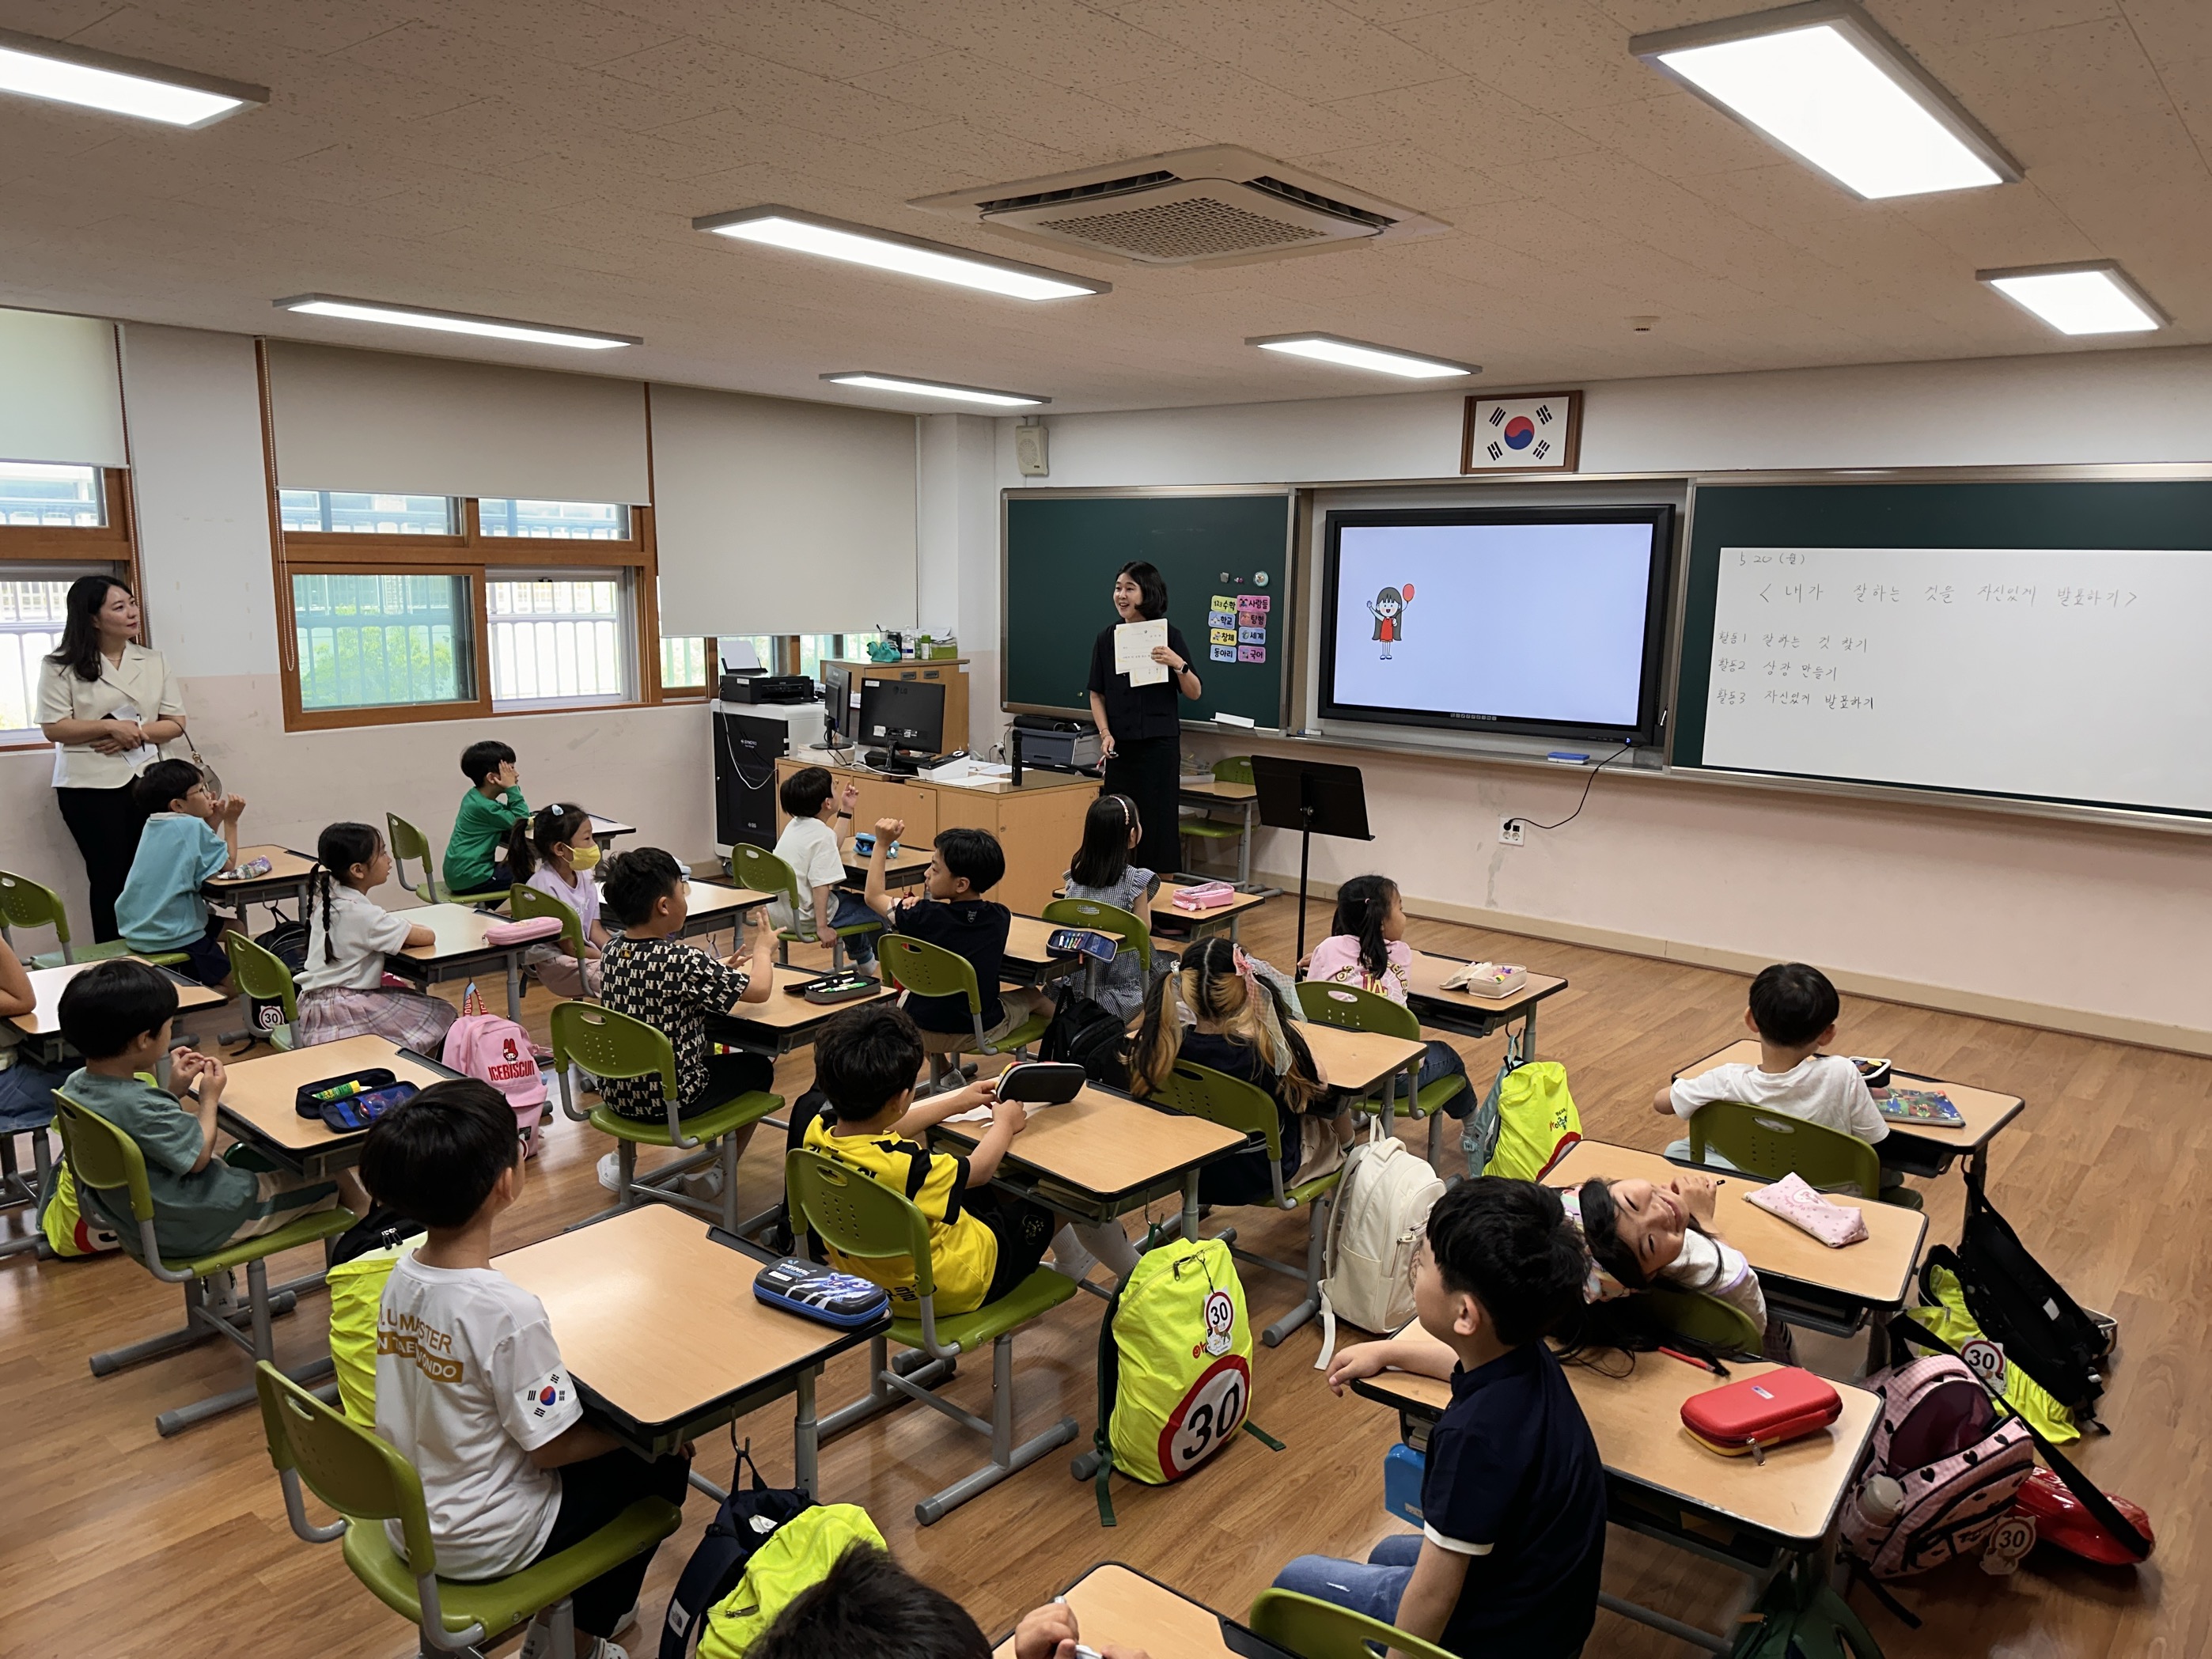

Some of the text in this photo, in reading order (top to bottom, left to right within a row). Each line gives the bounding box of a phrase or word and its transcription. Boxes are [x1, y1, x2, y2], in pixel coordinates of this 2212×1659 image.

[1785, 583, 1824, 604] 내가
[1854, 582, 1900, 603] 잘하는
[1924, 584, 1955, 604] 것을
[1977, 583, 2036, 608] 자신있게
[1222, 600, 1236, 612] 수학
[1220, 615, 1233, 626] 학교
[1250, 631, 1264, 640] 세계
[1718, 631, 1867, 653] 활동1 잘하는 것 찾기
[1214, 647, 1233, 658] 동아리
[1250, 650, 1263, 660] 국어
[1718, 657, 1837, 681] 활동2 상장 만들기
[1716, 687, 1746, 705] 활동3
[1824, 693, 1873, 710] 발표하기
[264, 1013, 278, 1024] 30
[780, 1263, 810, 1276] PRIMAL
[1210, 1301, 1229, 1325] 30
[400, 1313, 453, 1354] MASTER
[1968, 1349, 1995, 1370] 30
[1183, 1383, 1240, 1460] 30
[2001, 1530, 2026, 1548] 30
